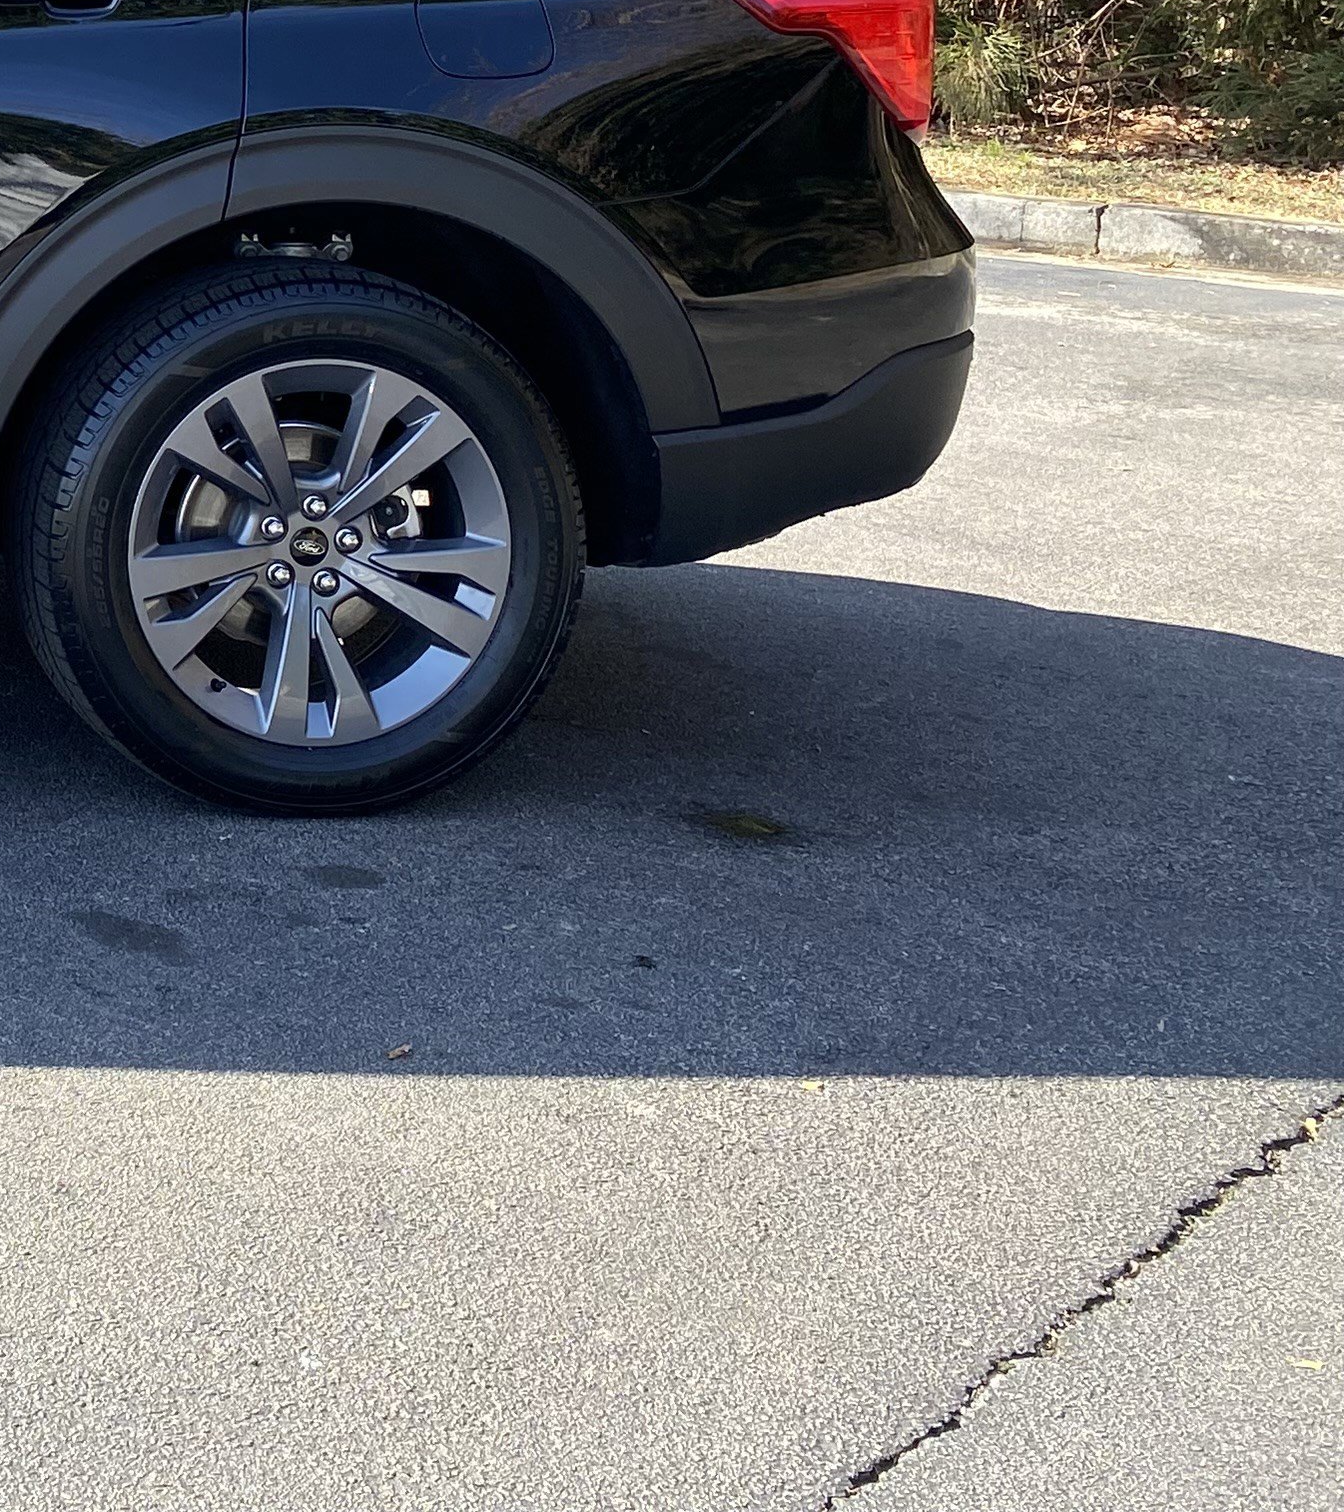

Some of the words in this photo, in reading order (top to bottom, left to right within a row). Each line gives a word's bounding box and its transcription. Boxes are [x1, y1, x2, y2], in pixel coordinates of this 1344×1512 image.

[262, 319, 385, 344] KELLY
[534, 466, 556, 523] EDGE
[297, 541, 321, 553] Ford
[536, 538, 558, 632] TOURING
